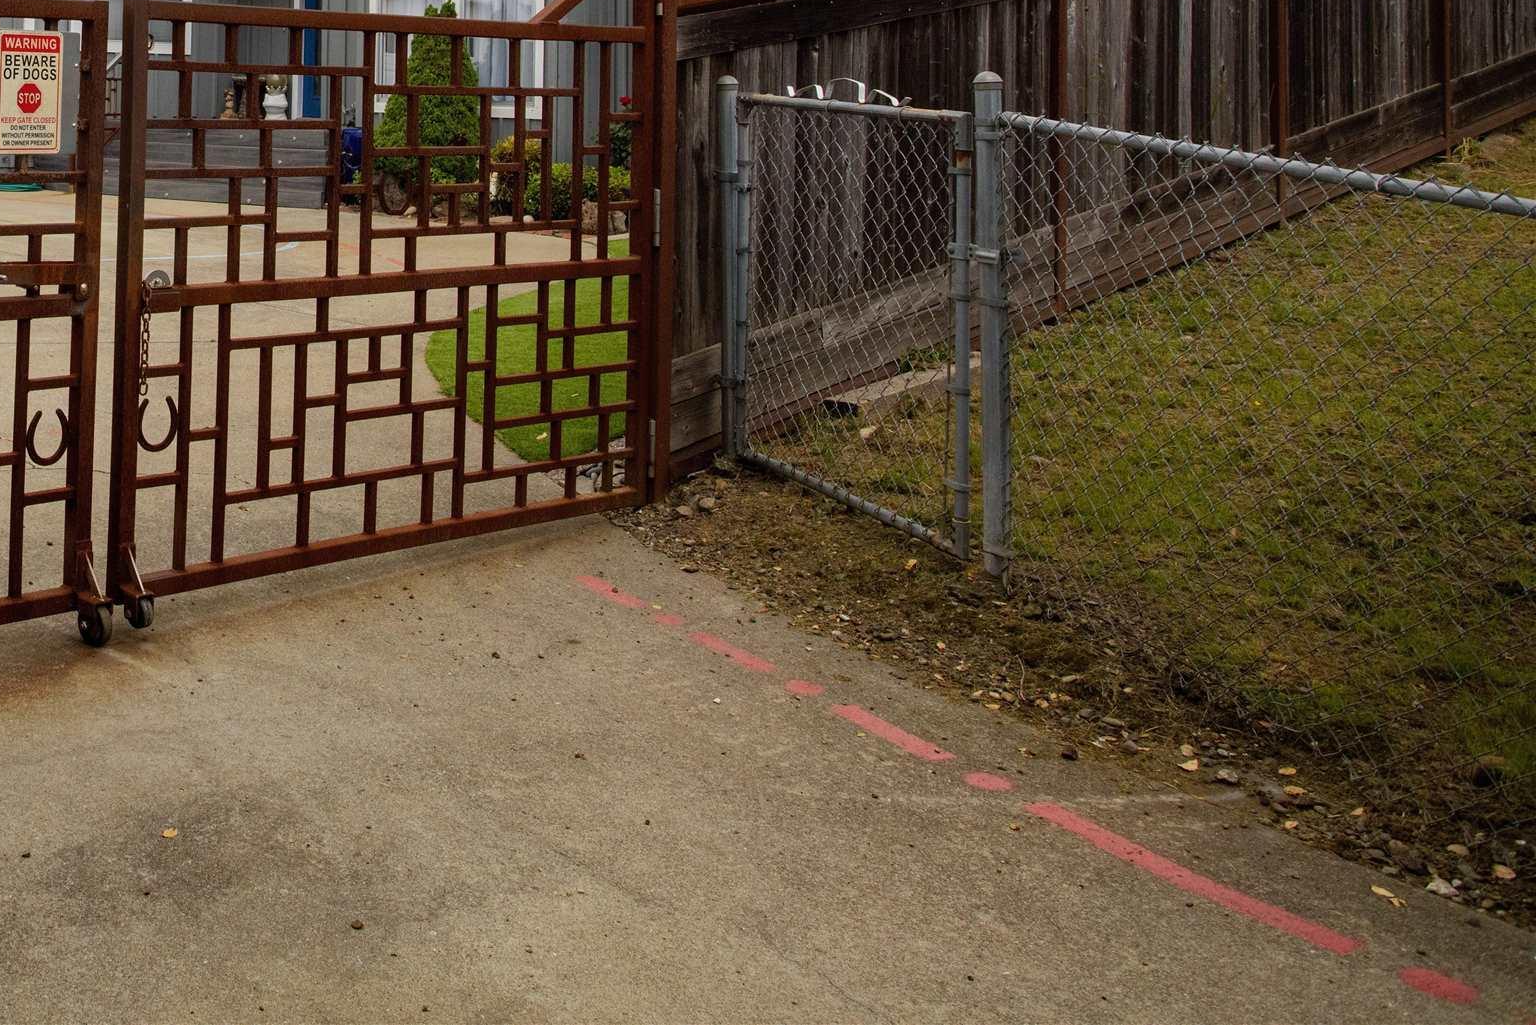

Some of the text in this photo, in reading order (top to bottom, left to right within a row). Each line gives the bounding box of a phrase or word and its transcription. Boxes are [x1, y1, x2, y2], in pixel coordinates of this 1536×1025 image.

[5, 37, 57, 50] WARNING
[4, 54, 56, 68] BEWARE
[3, 67, 57, 81] OF DOGS
[18, 93, 41, 104] STOP
[1, 116, 56, 124] KEEP GATE CLOSED
